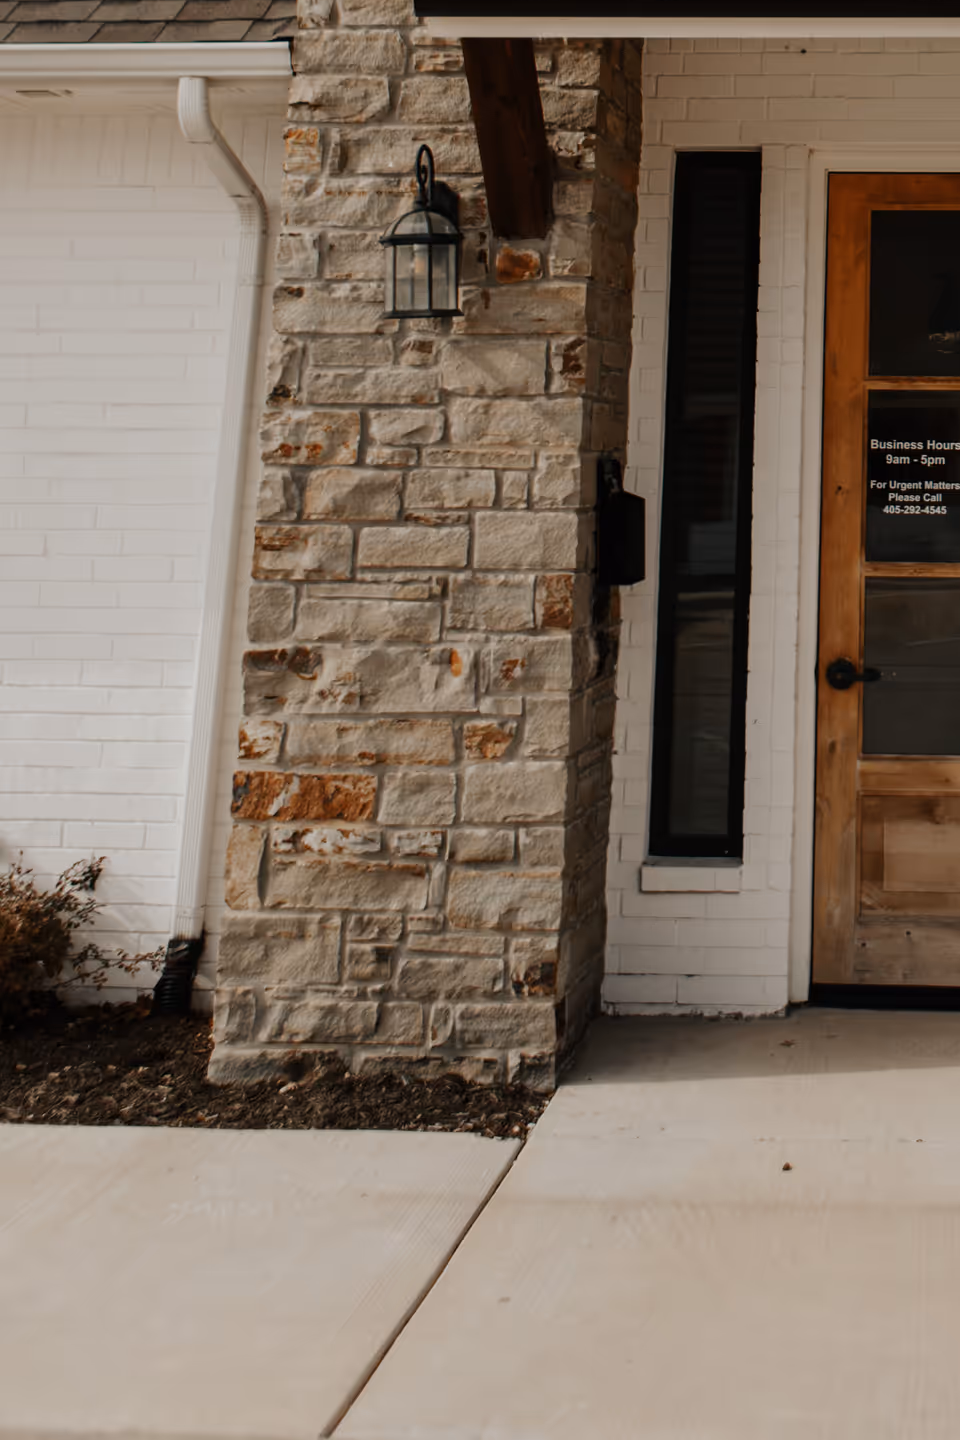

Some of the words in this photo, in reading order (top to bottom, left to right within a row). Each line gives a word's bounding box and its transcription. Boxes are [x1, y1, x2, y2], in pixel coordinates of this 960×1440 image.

[870, 439, 923, 450] Business
[886, 454, 910, 464] 9am
[920, 454, 946, 467] 5pm
[870, 480, 887, 489] For
[889, 480, 922, 491] Urgent
[924, 480, 960, 490] Matters
[888, 493, 920, 502] Please
[923, 493, 942, 502] Call
[883, 505, 947, 514] 405-292-4545
